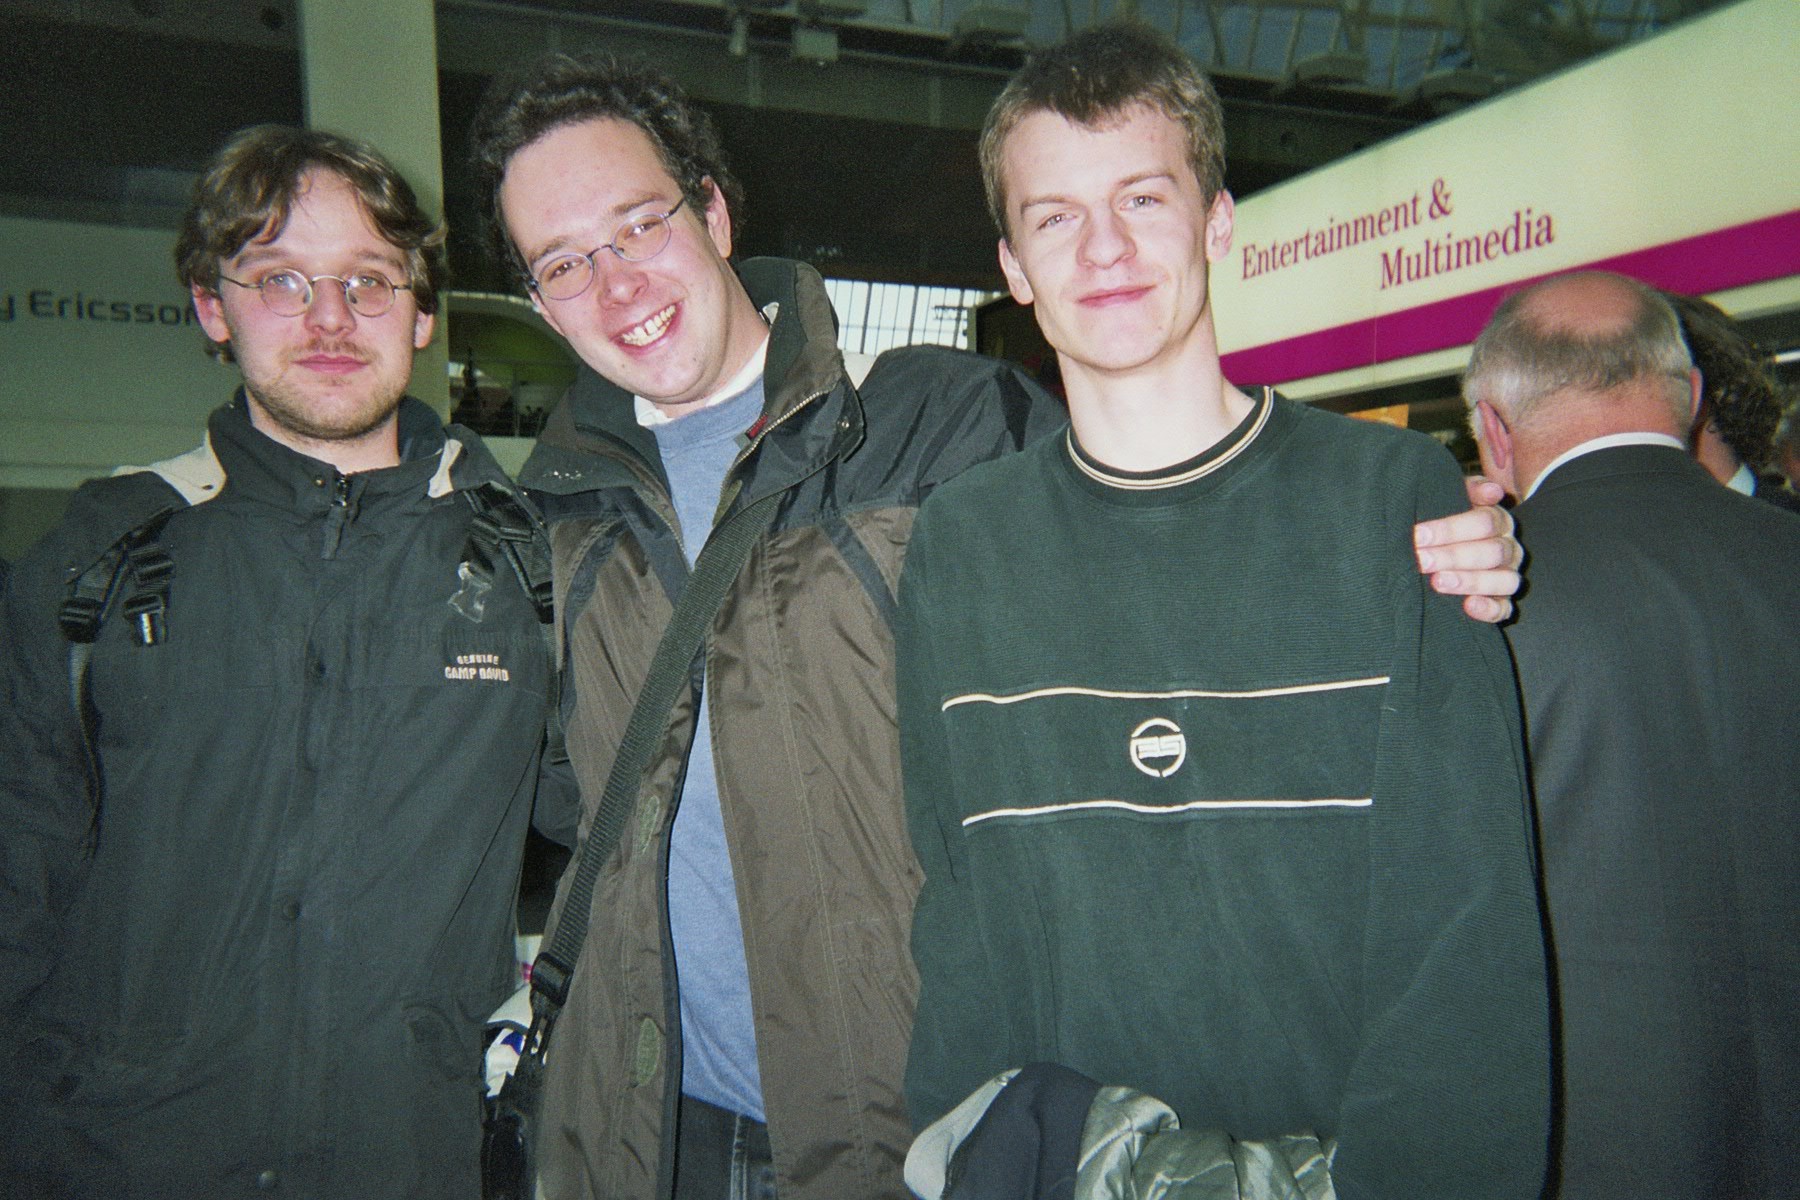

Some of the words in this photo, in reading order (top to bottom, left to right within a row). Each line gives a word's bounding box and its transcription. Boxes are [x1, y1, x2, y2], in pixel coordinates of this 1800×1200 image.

[1241, 190, 1422, 280] Entertainment
[1428, 177, 1453, 220] &
[1380, 208, 1555, 290] Multimedia
[444, 666, 477, 680] CAMP
[479, 667, 509, 682] DAVID
